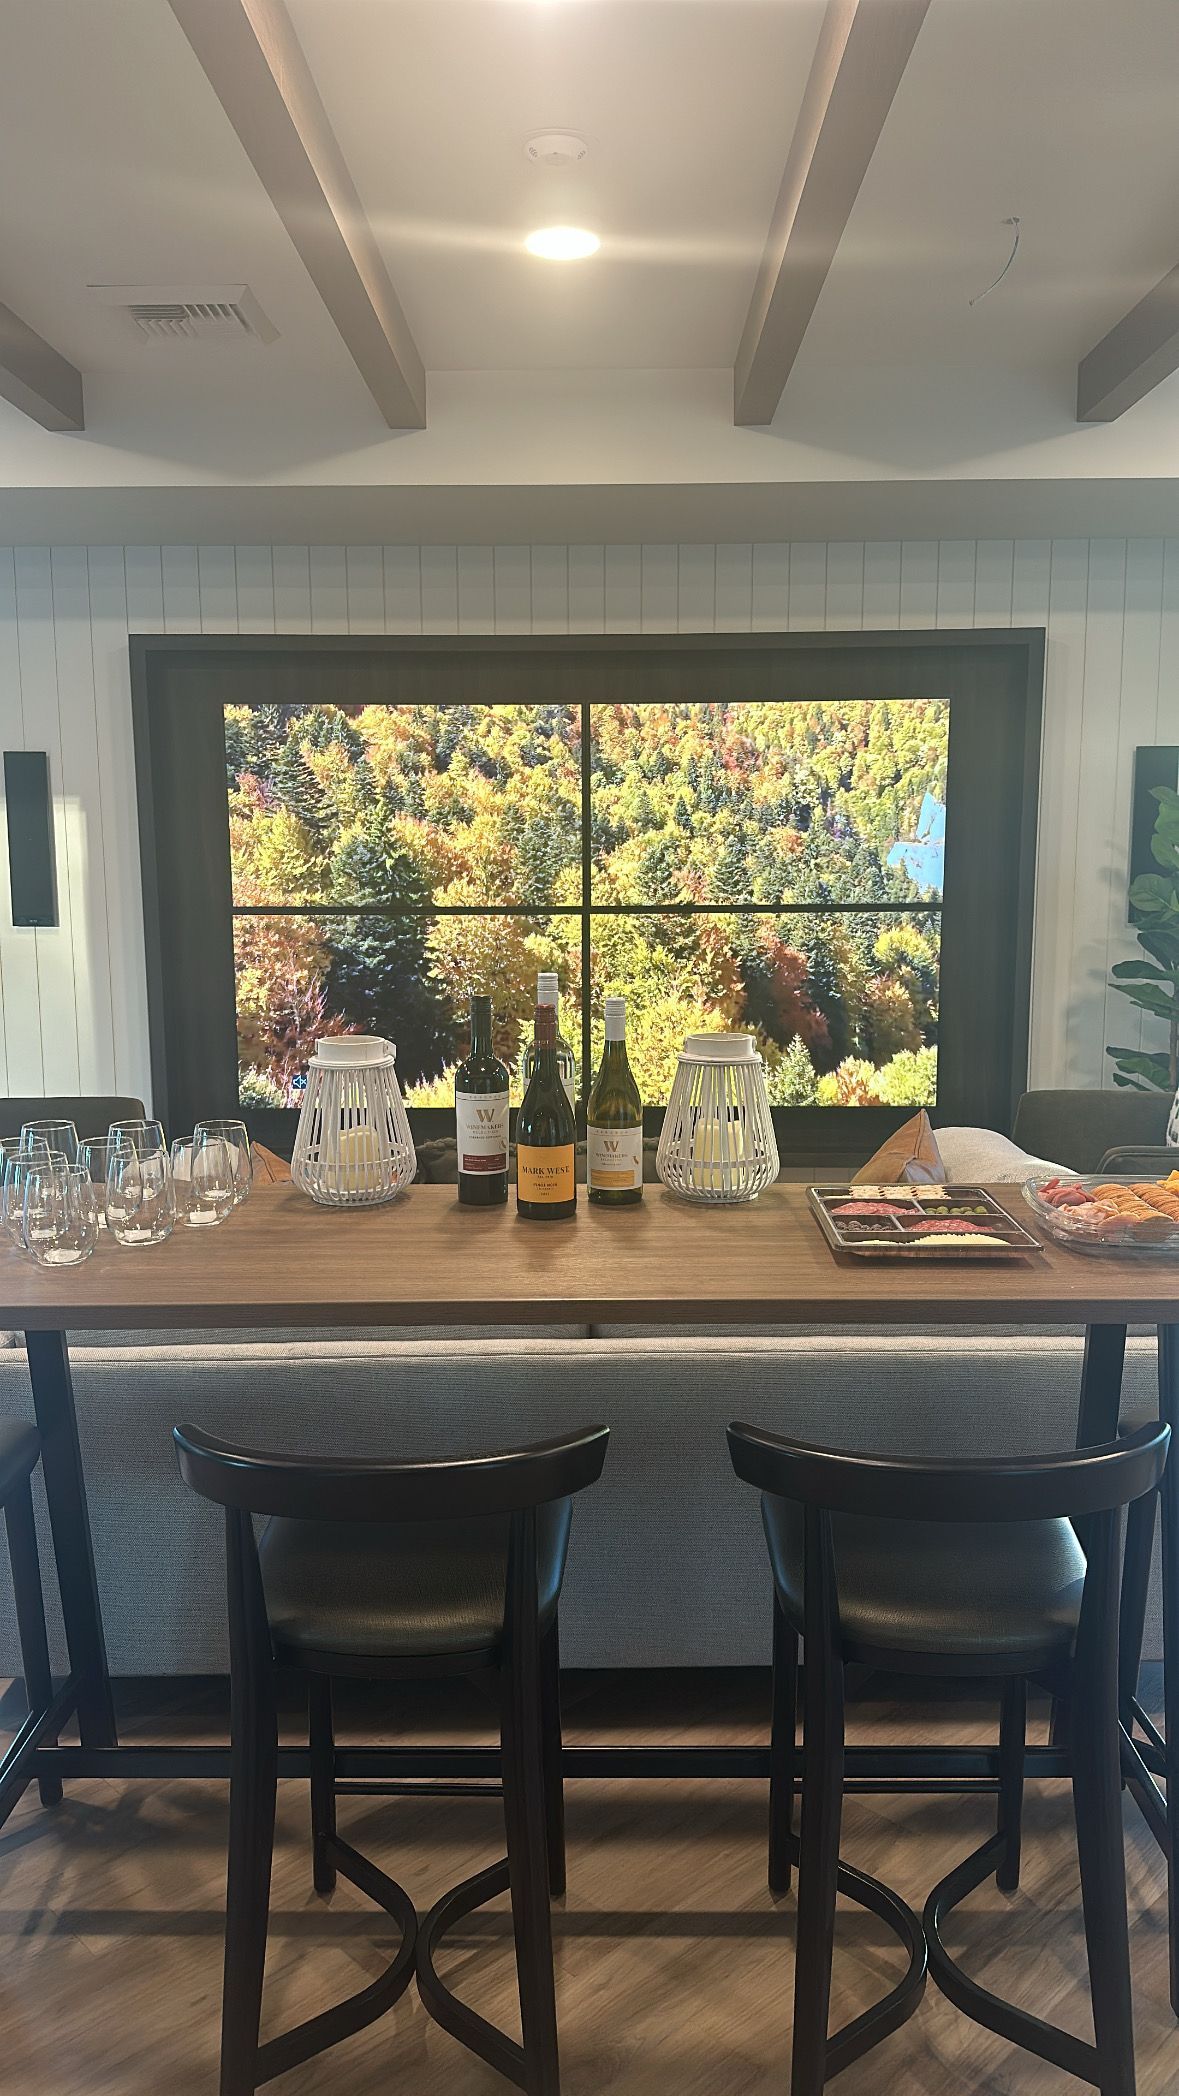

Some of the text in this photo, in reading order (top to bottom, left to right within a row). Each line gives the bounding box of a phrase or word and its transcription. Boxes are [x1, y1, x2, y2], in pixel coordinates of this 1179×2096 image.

[476, 1109, 495, 1123] W
[603, 1141, 619, 1152] W
[522, 1165, 570, 1175] MARK WEST
